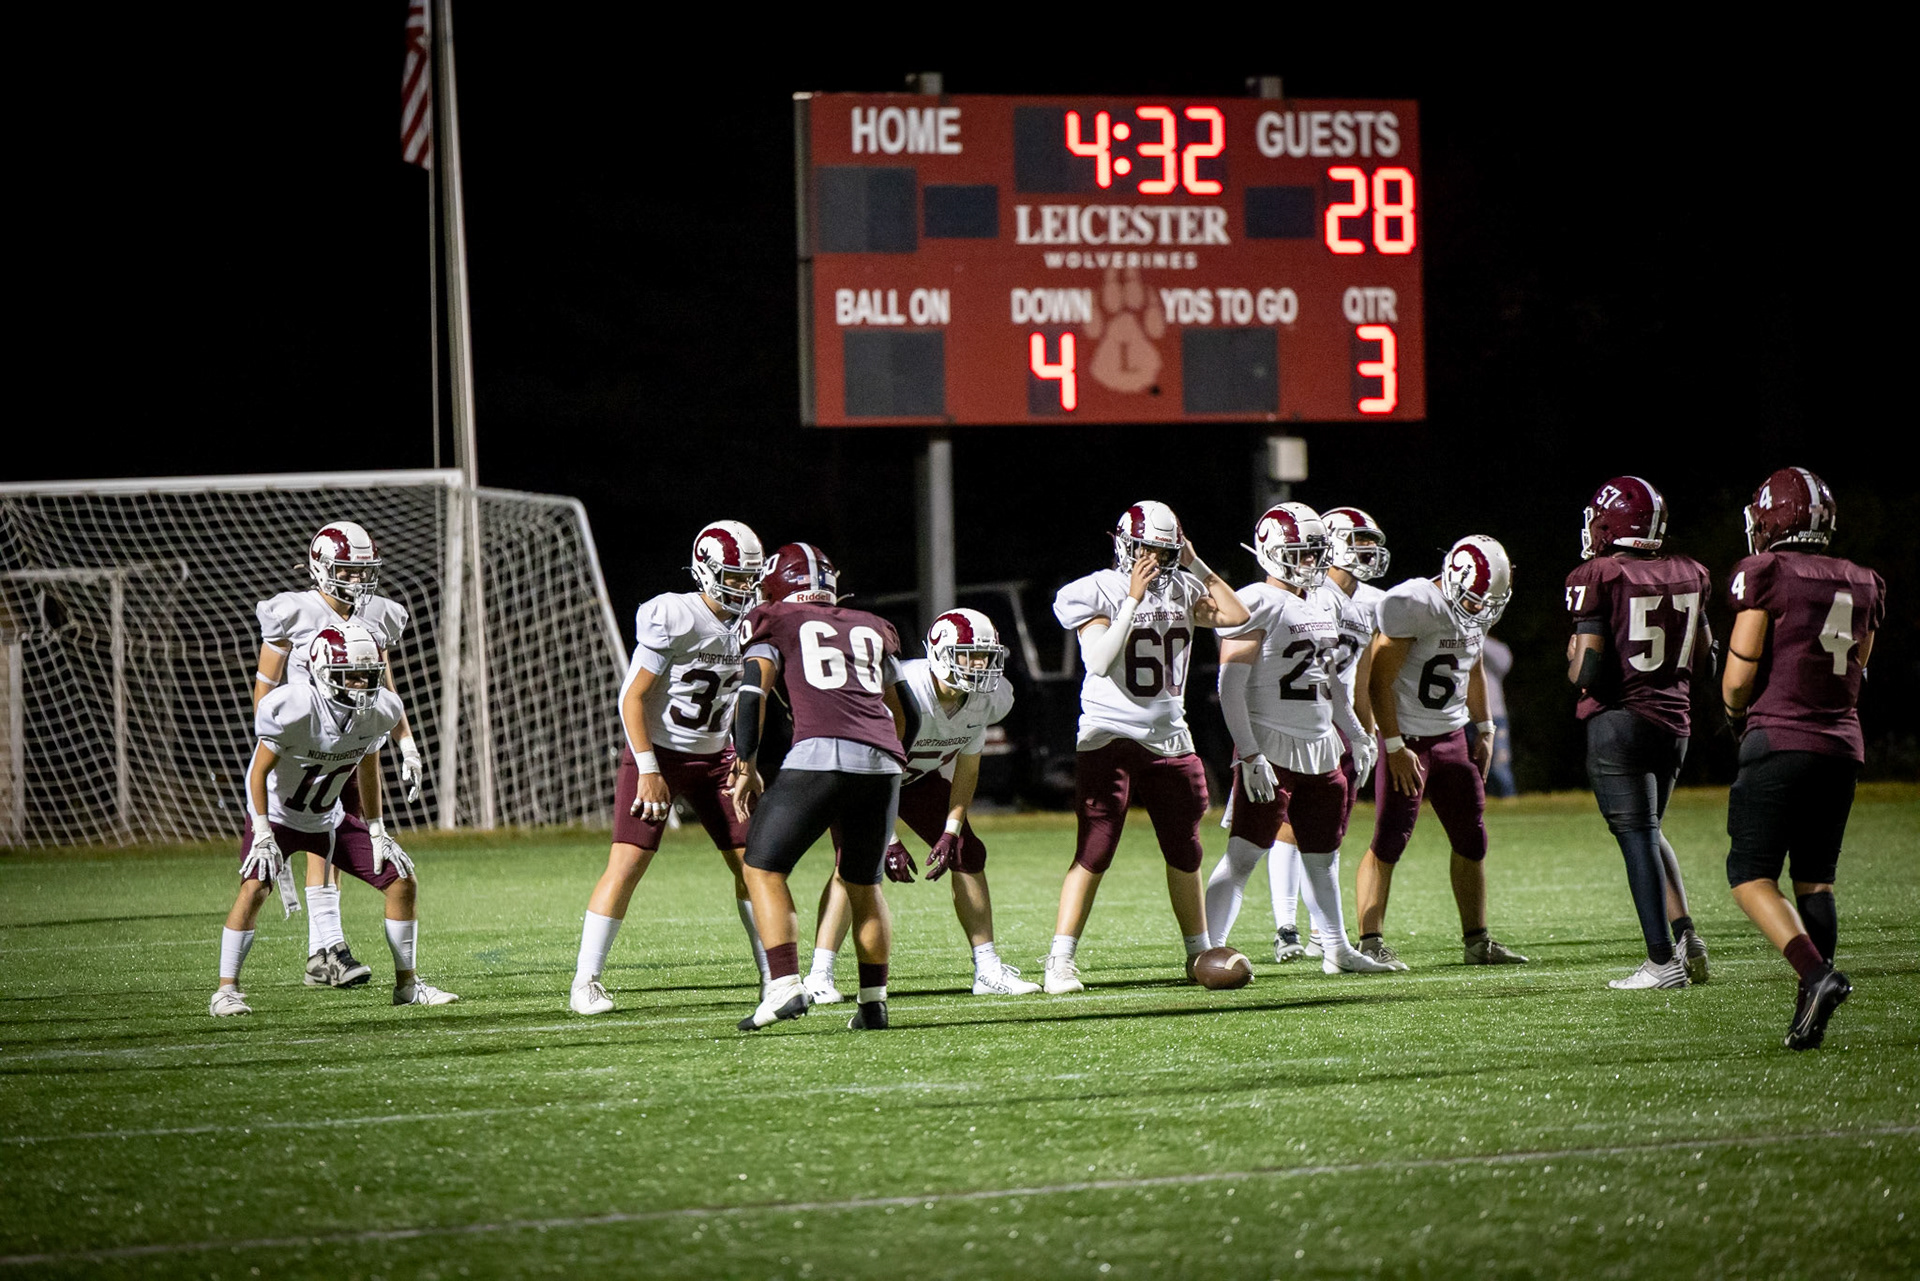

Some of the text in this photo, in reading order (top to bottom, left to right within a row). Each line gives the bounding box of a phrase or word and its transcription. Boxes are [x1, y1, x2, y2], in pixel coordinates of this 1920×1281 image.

[851, 106, 963, 154] HOME
[1065, 106, 1226, 195] 4:32
[1256, 110, 1401, 158] GUESTS
[1015, 204, 1231, 245] LEICESTER
[1324, 166, 1416, 255] 28
[1043, 251, 1198, 269] WOLVERINES
[835, 287, 950, 325] BALL ON
[1010, 287, 1093, 324] DOWN
[1160, 287, 1299, 324] YDS TO GO
[1342, 286, 1398, 324] QTR
[1029, 331, 1077, 411] 4
[1356, 324, 1398, 414] 3
[1597, 485, 1621, 509] 57
[1759, 485, 1772, 510] 4
[1565, 586, 1586, 611] 57
[1731, 571, 1746, 600] 4
[1628, 592, 1700, 673] 57
[1818, 591, 1858, 676] 4
[799, 620, 884, 694] 60
[1125, 627, 1192, 697] 60
[1418, 653, 1459, 710] 6
[284, 763, 357, 814] 10
